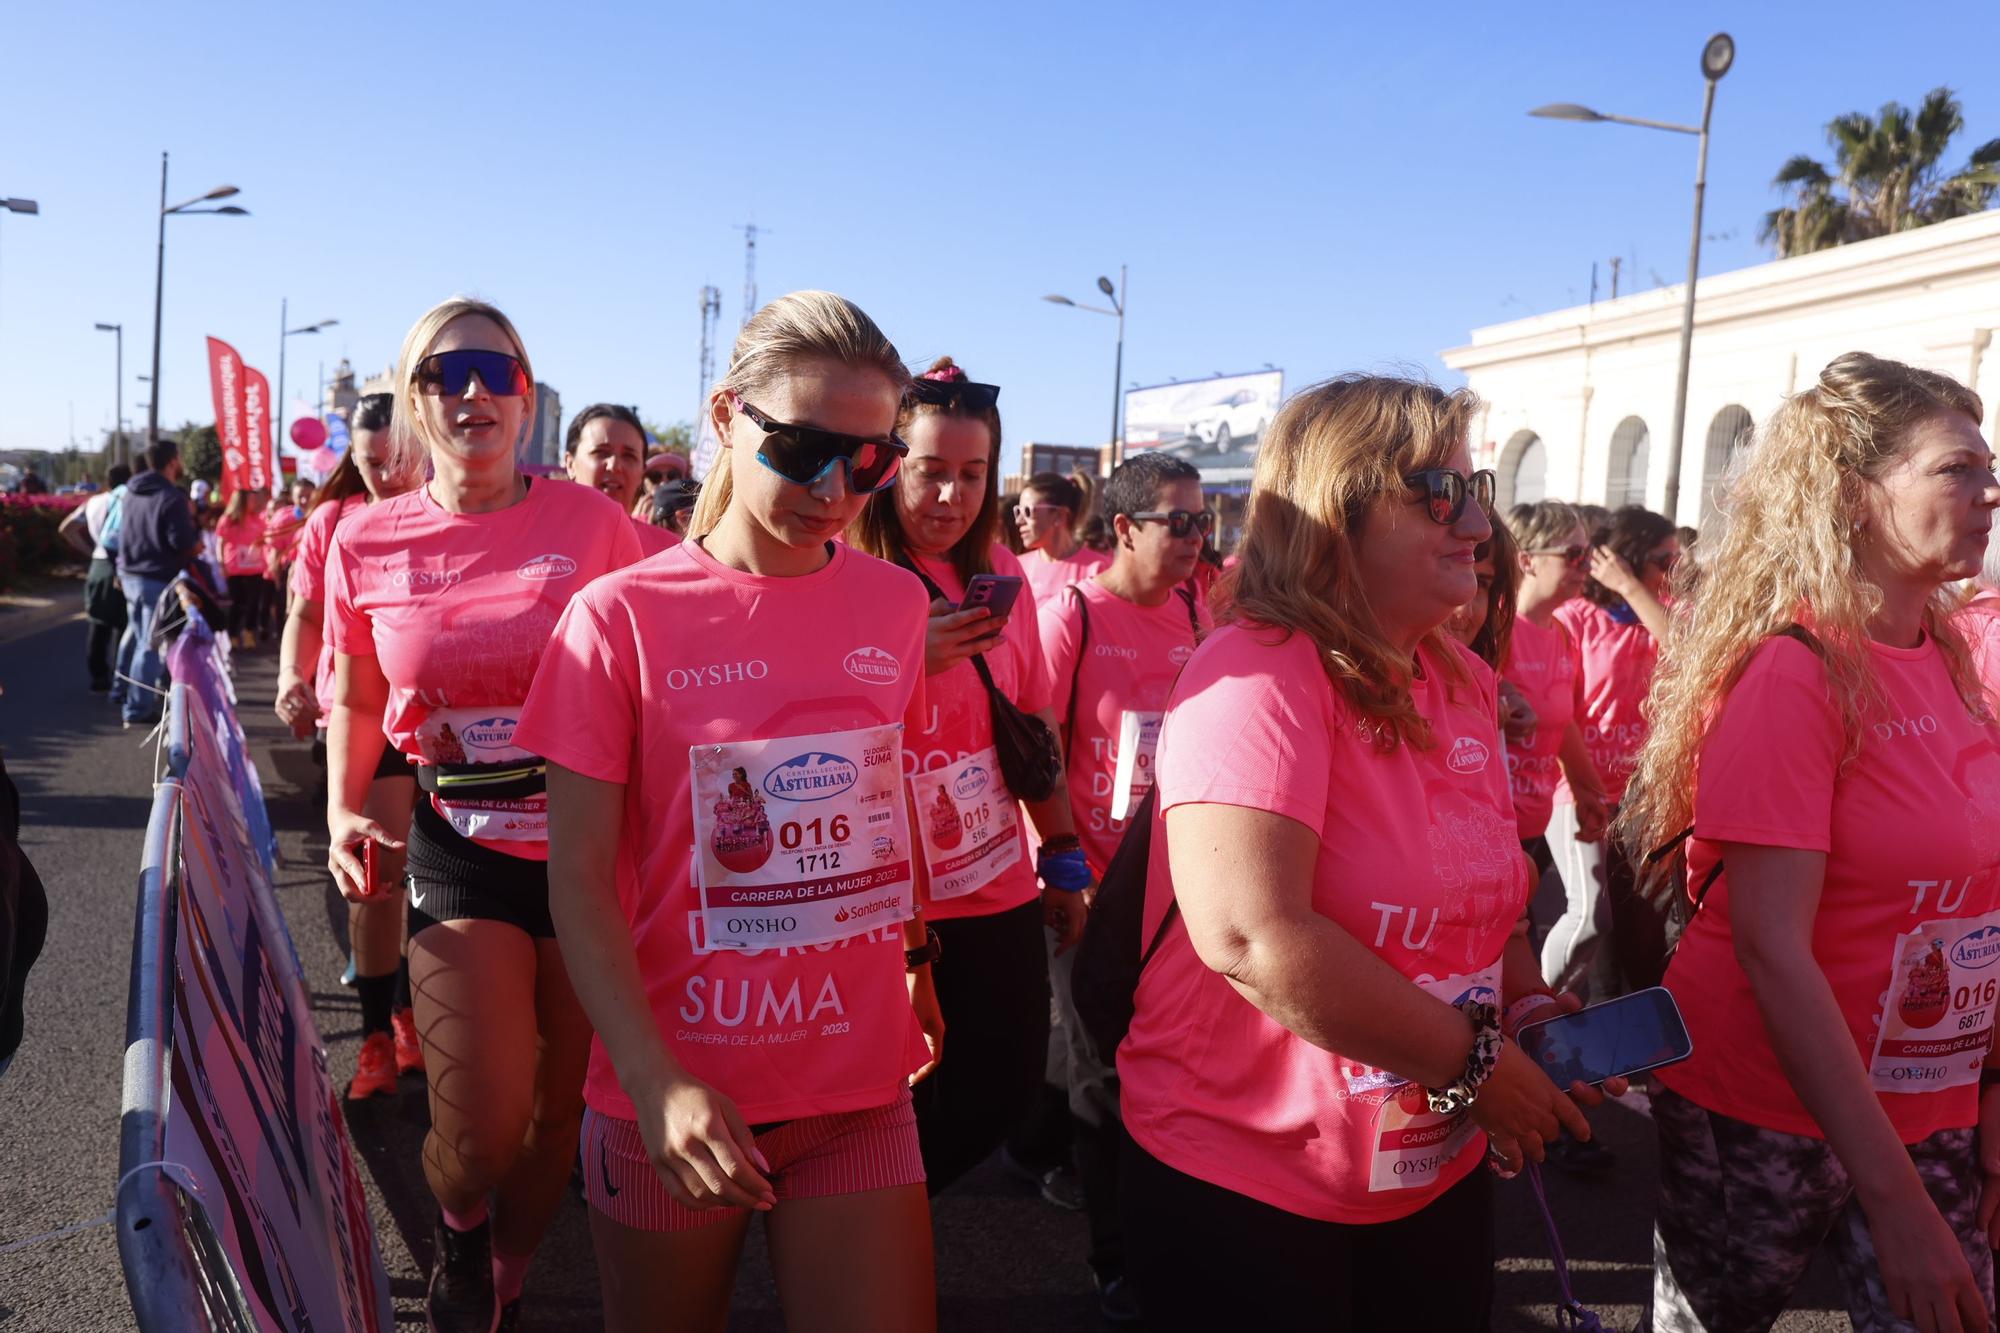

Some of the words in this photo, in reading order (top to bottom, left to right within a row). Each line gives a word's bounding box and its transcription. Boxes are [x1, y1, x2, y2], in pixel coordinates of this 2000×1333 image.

[393, 570, 461, 586] OYSHO
[666, 660, 768, 690] OYSHO
[851, 658, 898, 677] ASTURIANA
[863, 752, 892, 768] SUMA
[772, 771, 852, 793] ASTURIANA
[964, 802, 989, 829] 016
[779, 814, 850, 850] 016
[796, 851, 841, 874] 1712
[730, 887, 794, 902] CARRERA
[797, 886, 815, 898] DE
[818, 884, 834, 895] LA
[836, 875, 872, 893] MUJER
[875, 869, 898, 883] 2023
[944, 871, 978, 890] OYSHO
[1907, 876, 1972, 914] TU
[851, 895, 900, 920] Santander
[727, 916, 797, 934] OYSHO
[1370, 901, 1439, 951] TU
[1956, 944, 2000, 961] ASTURIAN
[679, 972, 845, 1027] SUMA
[1953, 978, 1996, 1011] 016
[1958, 1010, 1986, 1030] 6877
[676, 1029, 728, 1045] CARRERA
[731, 1035, 747, 1046] DE
[750, 1034, 765, 1045] LA
[767, 1029, 808, 1044] MUJER
[821, 1021, 850, 1037] 2023
[1902, 1043, 1952, 1054] CARRERA
[1953, 1040, 1964, 1051] DE
[1965, 1037, 1977, 1048] LA
[1891, 1066, 1948, 1081] OYSHO
[1402, 1125, 1450, 1144] CARRERA
[1393, 1155, 1441, 1175] OYSH
